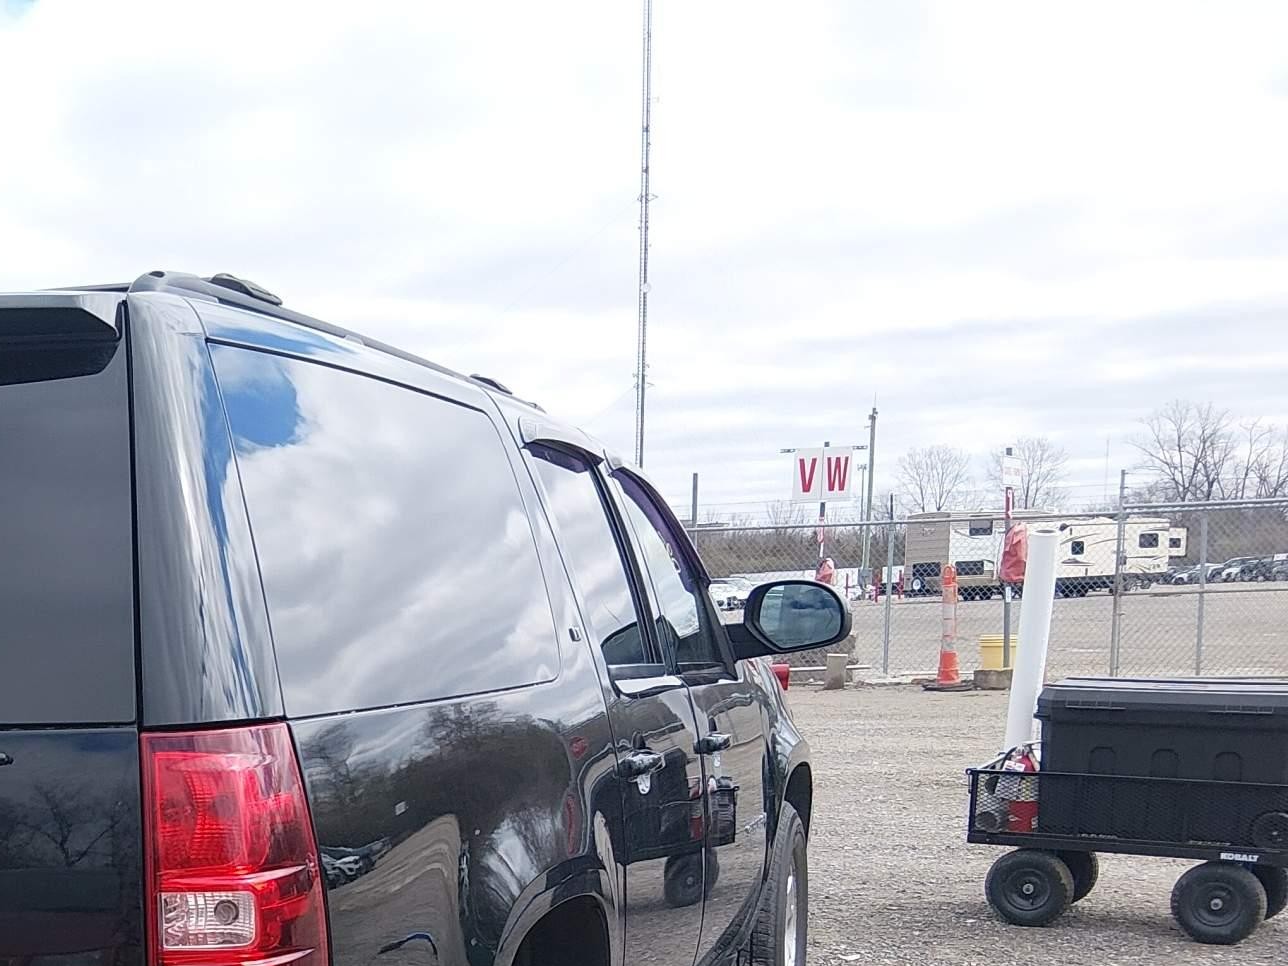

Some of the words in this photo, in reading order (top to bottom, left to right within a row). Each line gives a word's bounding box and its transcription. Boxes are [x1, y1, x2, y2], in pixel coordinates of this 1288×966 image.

[799, 457, 817, 493] V
[827, 455, 849, 491] W
[1220, 852, 1259, 862] KOBALT
